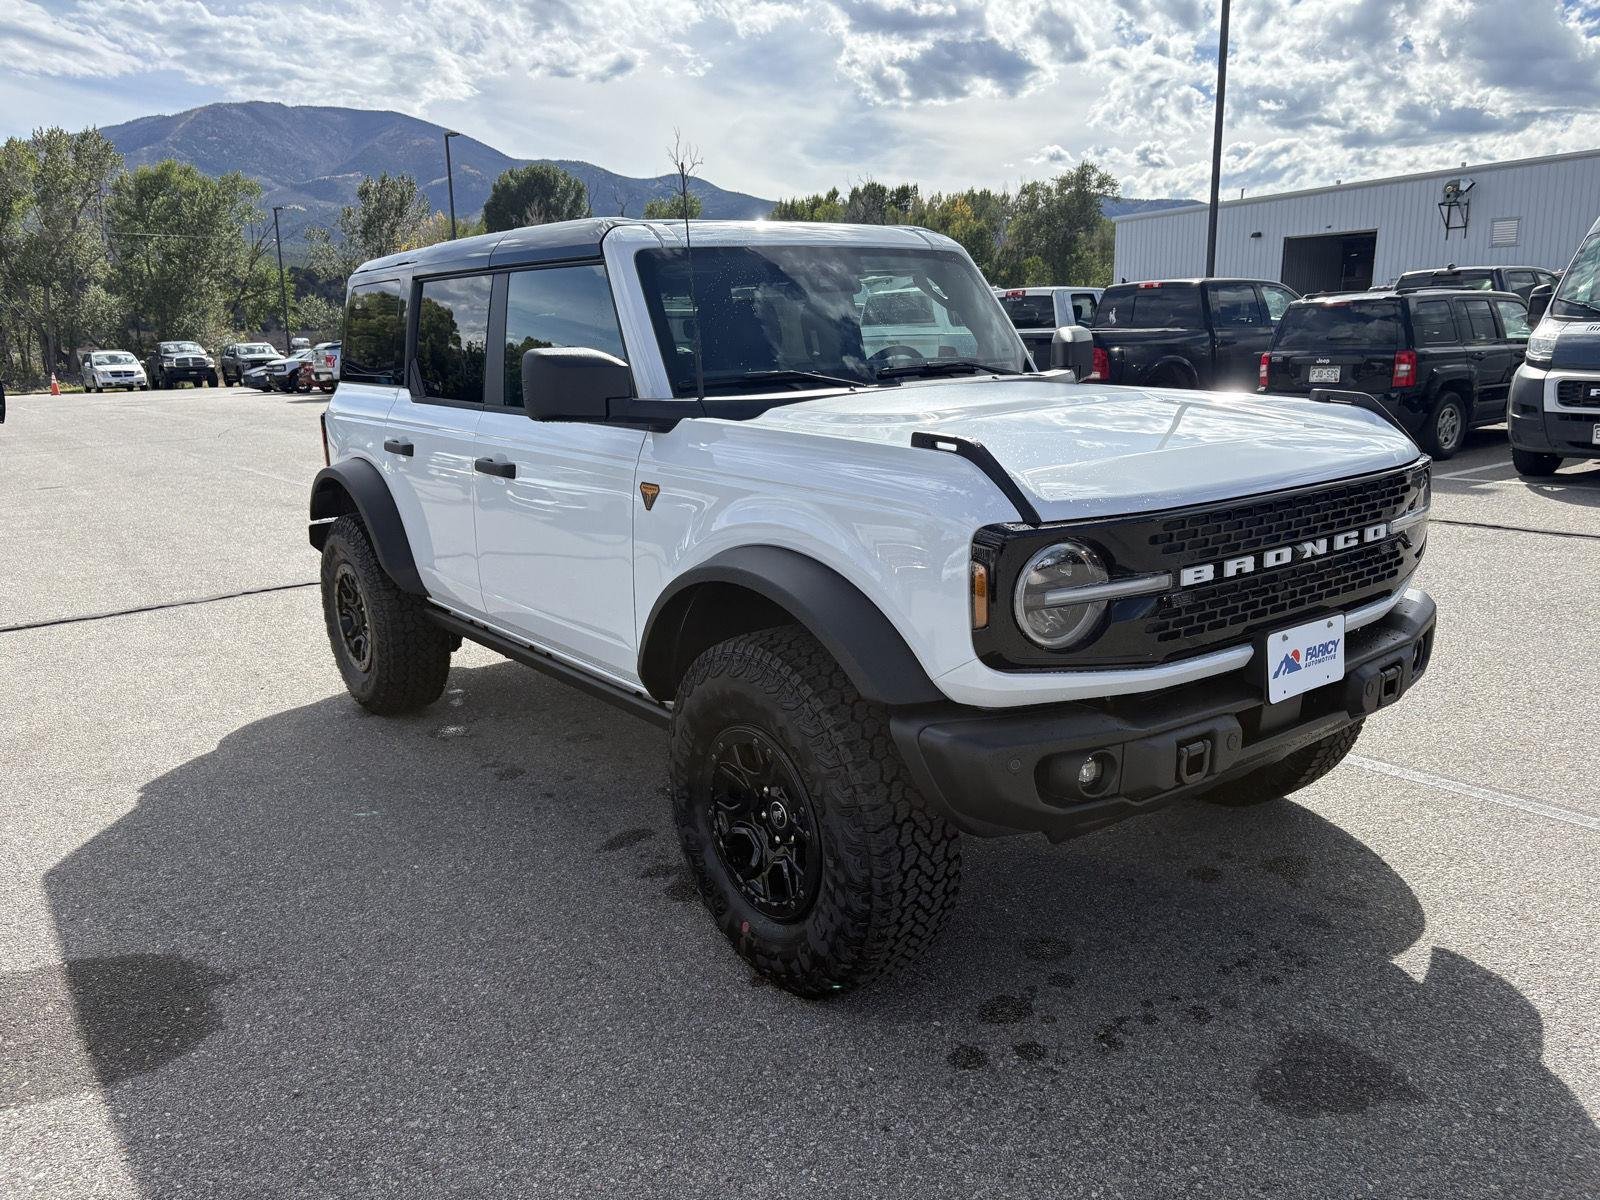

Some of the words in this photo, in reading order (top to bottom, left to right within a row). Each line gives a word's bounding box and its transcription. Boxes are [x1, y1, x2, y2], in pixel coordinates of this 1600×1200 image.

[1180, 523, 1388, 587] BRONCO
[1304, 653, 1337, 668] AUTOMOTIVE
[1305, 638, 1341, 662] FARICY
